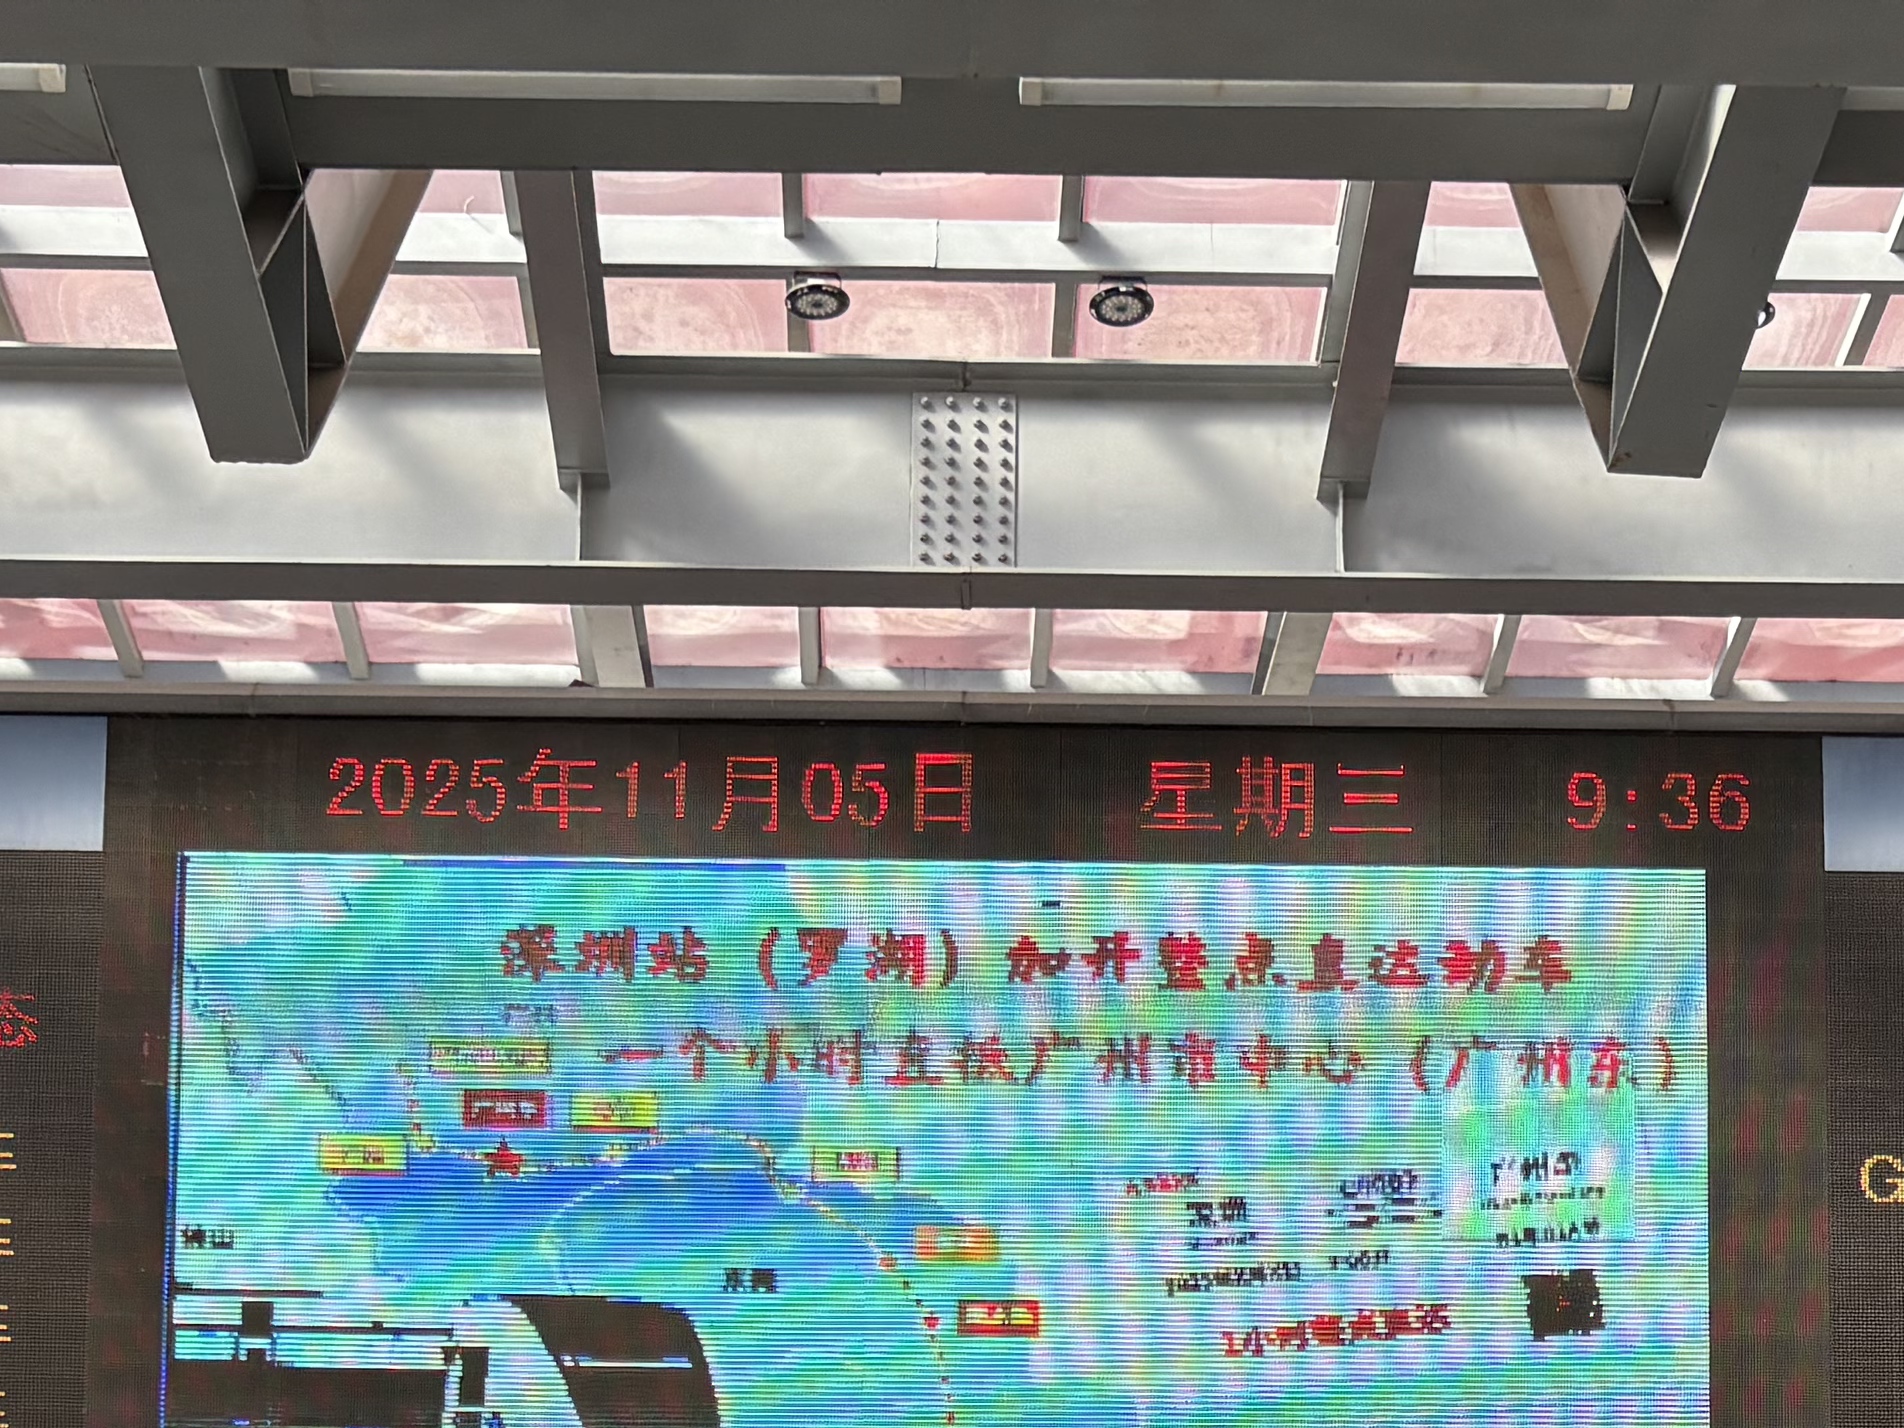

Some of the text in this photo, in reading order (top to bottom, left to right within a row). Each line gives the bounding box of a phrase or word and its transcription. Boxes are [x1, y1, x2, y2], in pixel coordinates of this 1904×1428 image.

[327, 749, 1750, 839] 2025年11月05日 星期三 9:36
